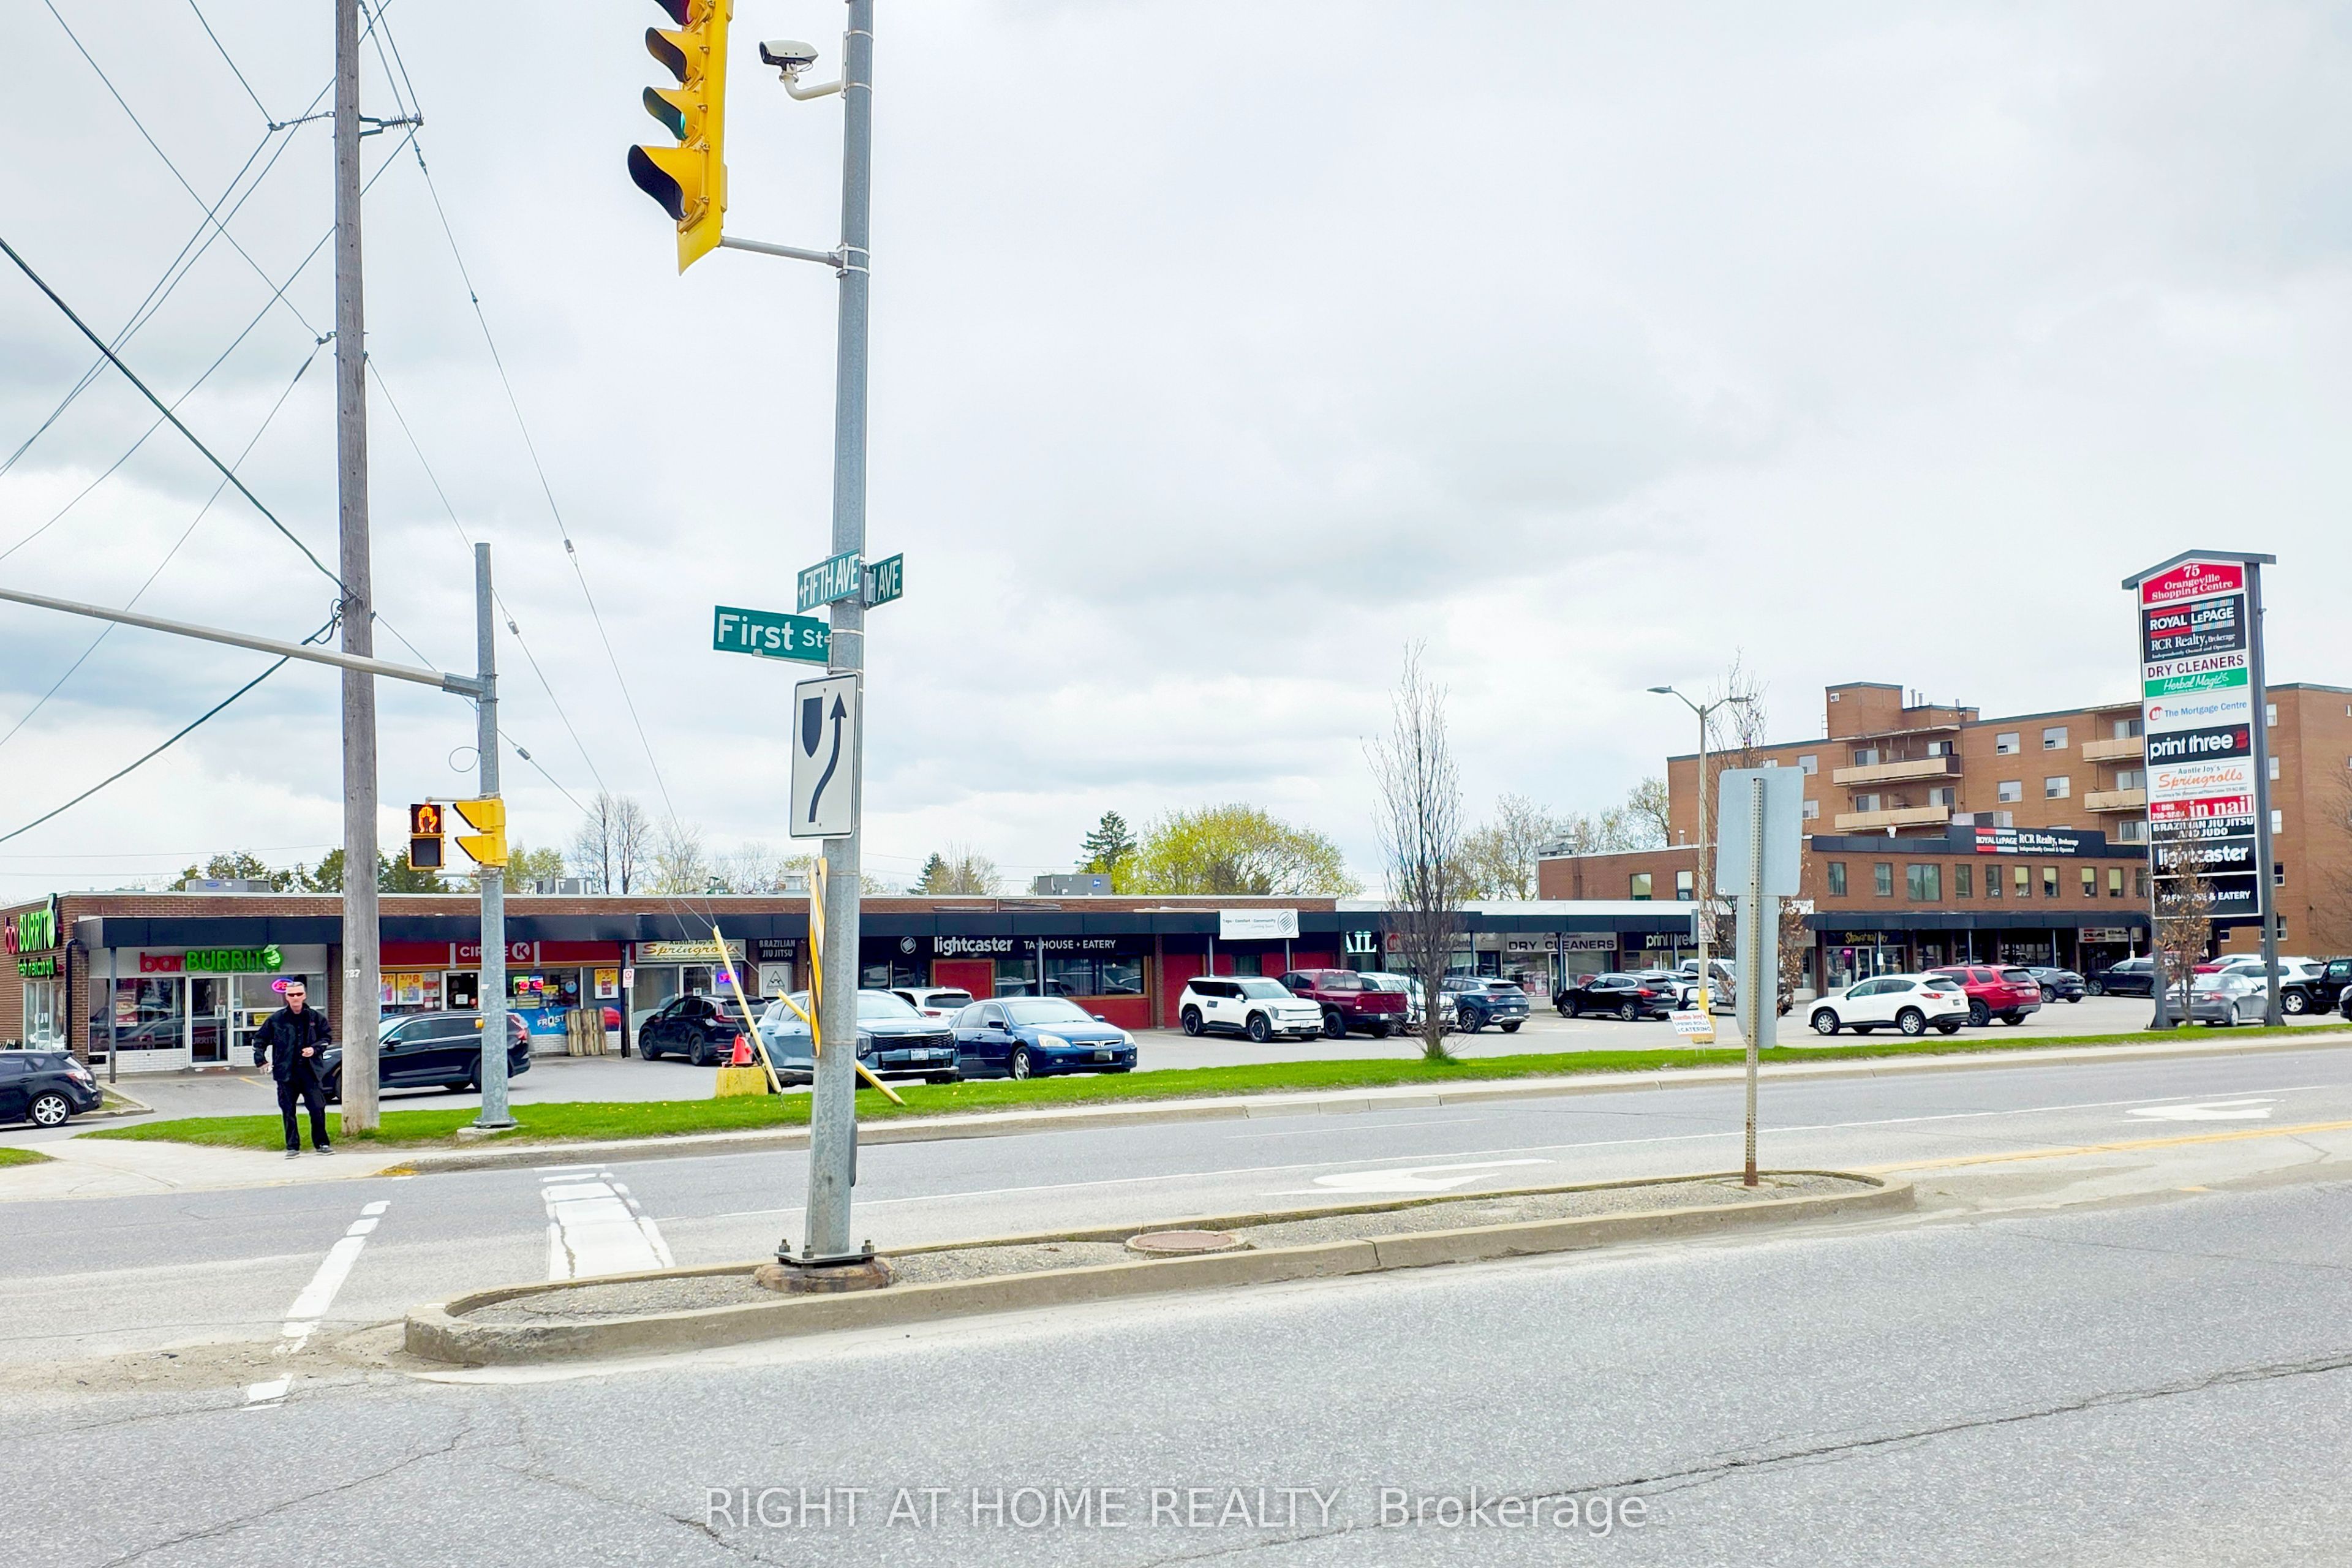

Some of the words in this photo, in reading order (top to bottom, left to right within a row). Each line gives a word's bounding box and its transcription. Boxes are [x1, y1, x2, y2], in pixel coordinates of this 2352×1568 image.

[803, 562, 834, 607] FIFTH
[834, 552, 859, 595] AVE
[2183, 564, 2201, 578] 75
[877, 559, 900, 601] AVE
[2164, 573, 2220, 591] Orangeville
[2151, 586, 2198, 600] Shopping
[2199, 581, 2233, 593] Centre
[2149, 614, 2188, 631] ROYAL
[717, 613, 794, 651] First
[802, 629, 824, 649] St
[2150, 638, 2173, 651] RCR
[2175, 633, 2208, 648] Realty,
[2147, 663, 2173, 679] DRY
[2177, 654, 2244, 674] CLEANERS
[2163, 676, 2195, 691] Herbal
[2165, 709, 2179, 718] The
[2180, 704, 2218, 716] Mortgage
[2220, 701, 2247, 711] Centre
[2150, 736, 2186, 760] print
[2188, 733, 2234, 753] three
[2203, 765, 2221, 774] Joy's
[2158, 768, 2244, 790] Springrolls
[2213, 796, 2253, 816] nail
[2208, 818, 2225, 829] JIU
[2225, 816, 2255, 827] JITSU
[1975, 835, 1996, 845] ROYAL
[2019, 834, 2035, 844] RCR
[2200, 827, 2228, 837] JUDO
[2218, 891, 2252, 900] EATERY
[759, 939, 796, 948] BRAZILIAN
[933, 936, 1013, 956] lightcaster
[1023, 940, 1074, 950] TAHOUSE
[1082, 940, 1116, 949] EATERY
[1509, 941, 1537, 950] DRY
[1545, 940, 1615, 950] CLEANERS
[1646, 931, 1668, 949] print
[459, 946, 508, 957] CIRE
[642, 943, 741, 957] Springrols
[774, 949, 793, 957] JITSU
